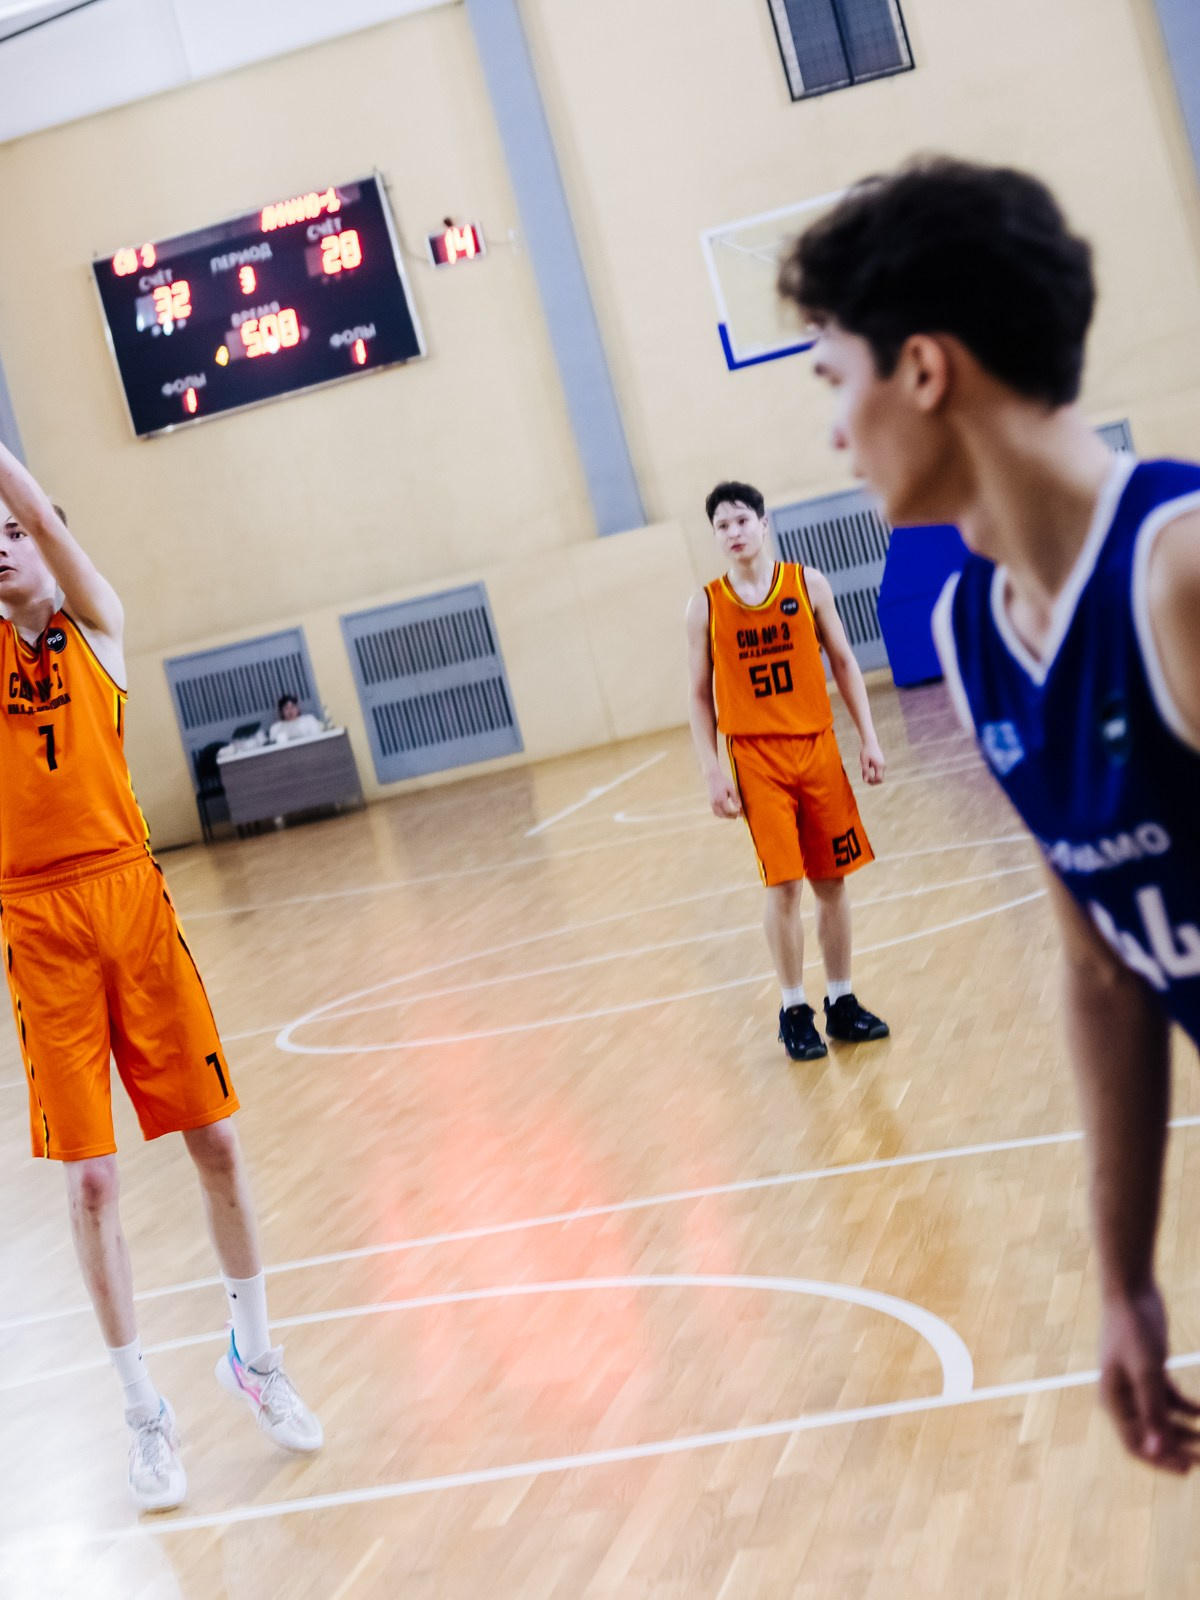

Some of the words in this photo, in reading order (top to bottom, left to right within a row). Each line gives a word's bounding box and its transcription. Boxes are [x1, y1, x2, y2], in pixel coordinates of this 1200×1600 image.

[210, 242, 273, 275] ПЕРИОД
[445, 223, 475, 266] 14
[153, 280, 192, 325] 32
[329, 323, 376, 348] ФОЛЫ
[161, 372, 207, 396] ФОЛЫ
[749, 660, 794, 699] 50
[832, 826, 862, 868] 50
[205, 1052, 230, 1100] 1
